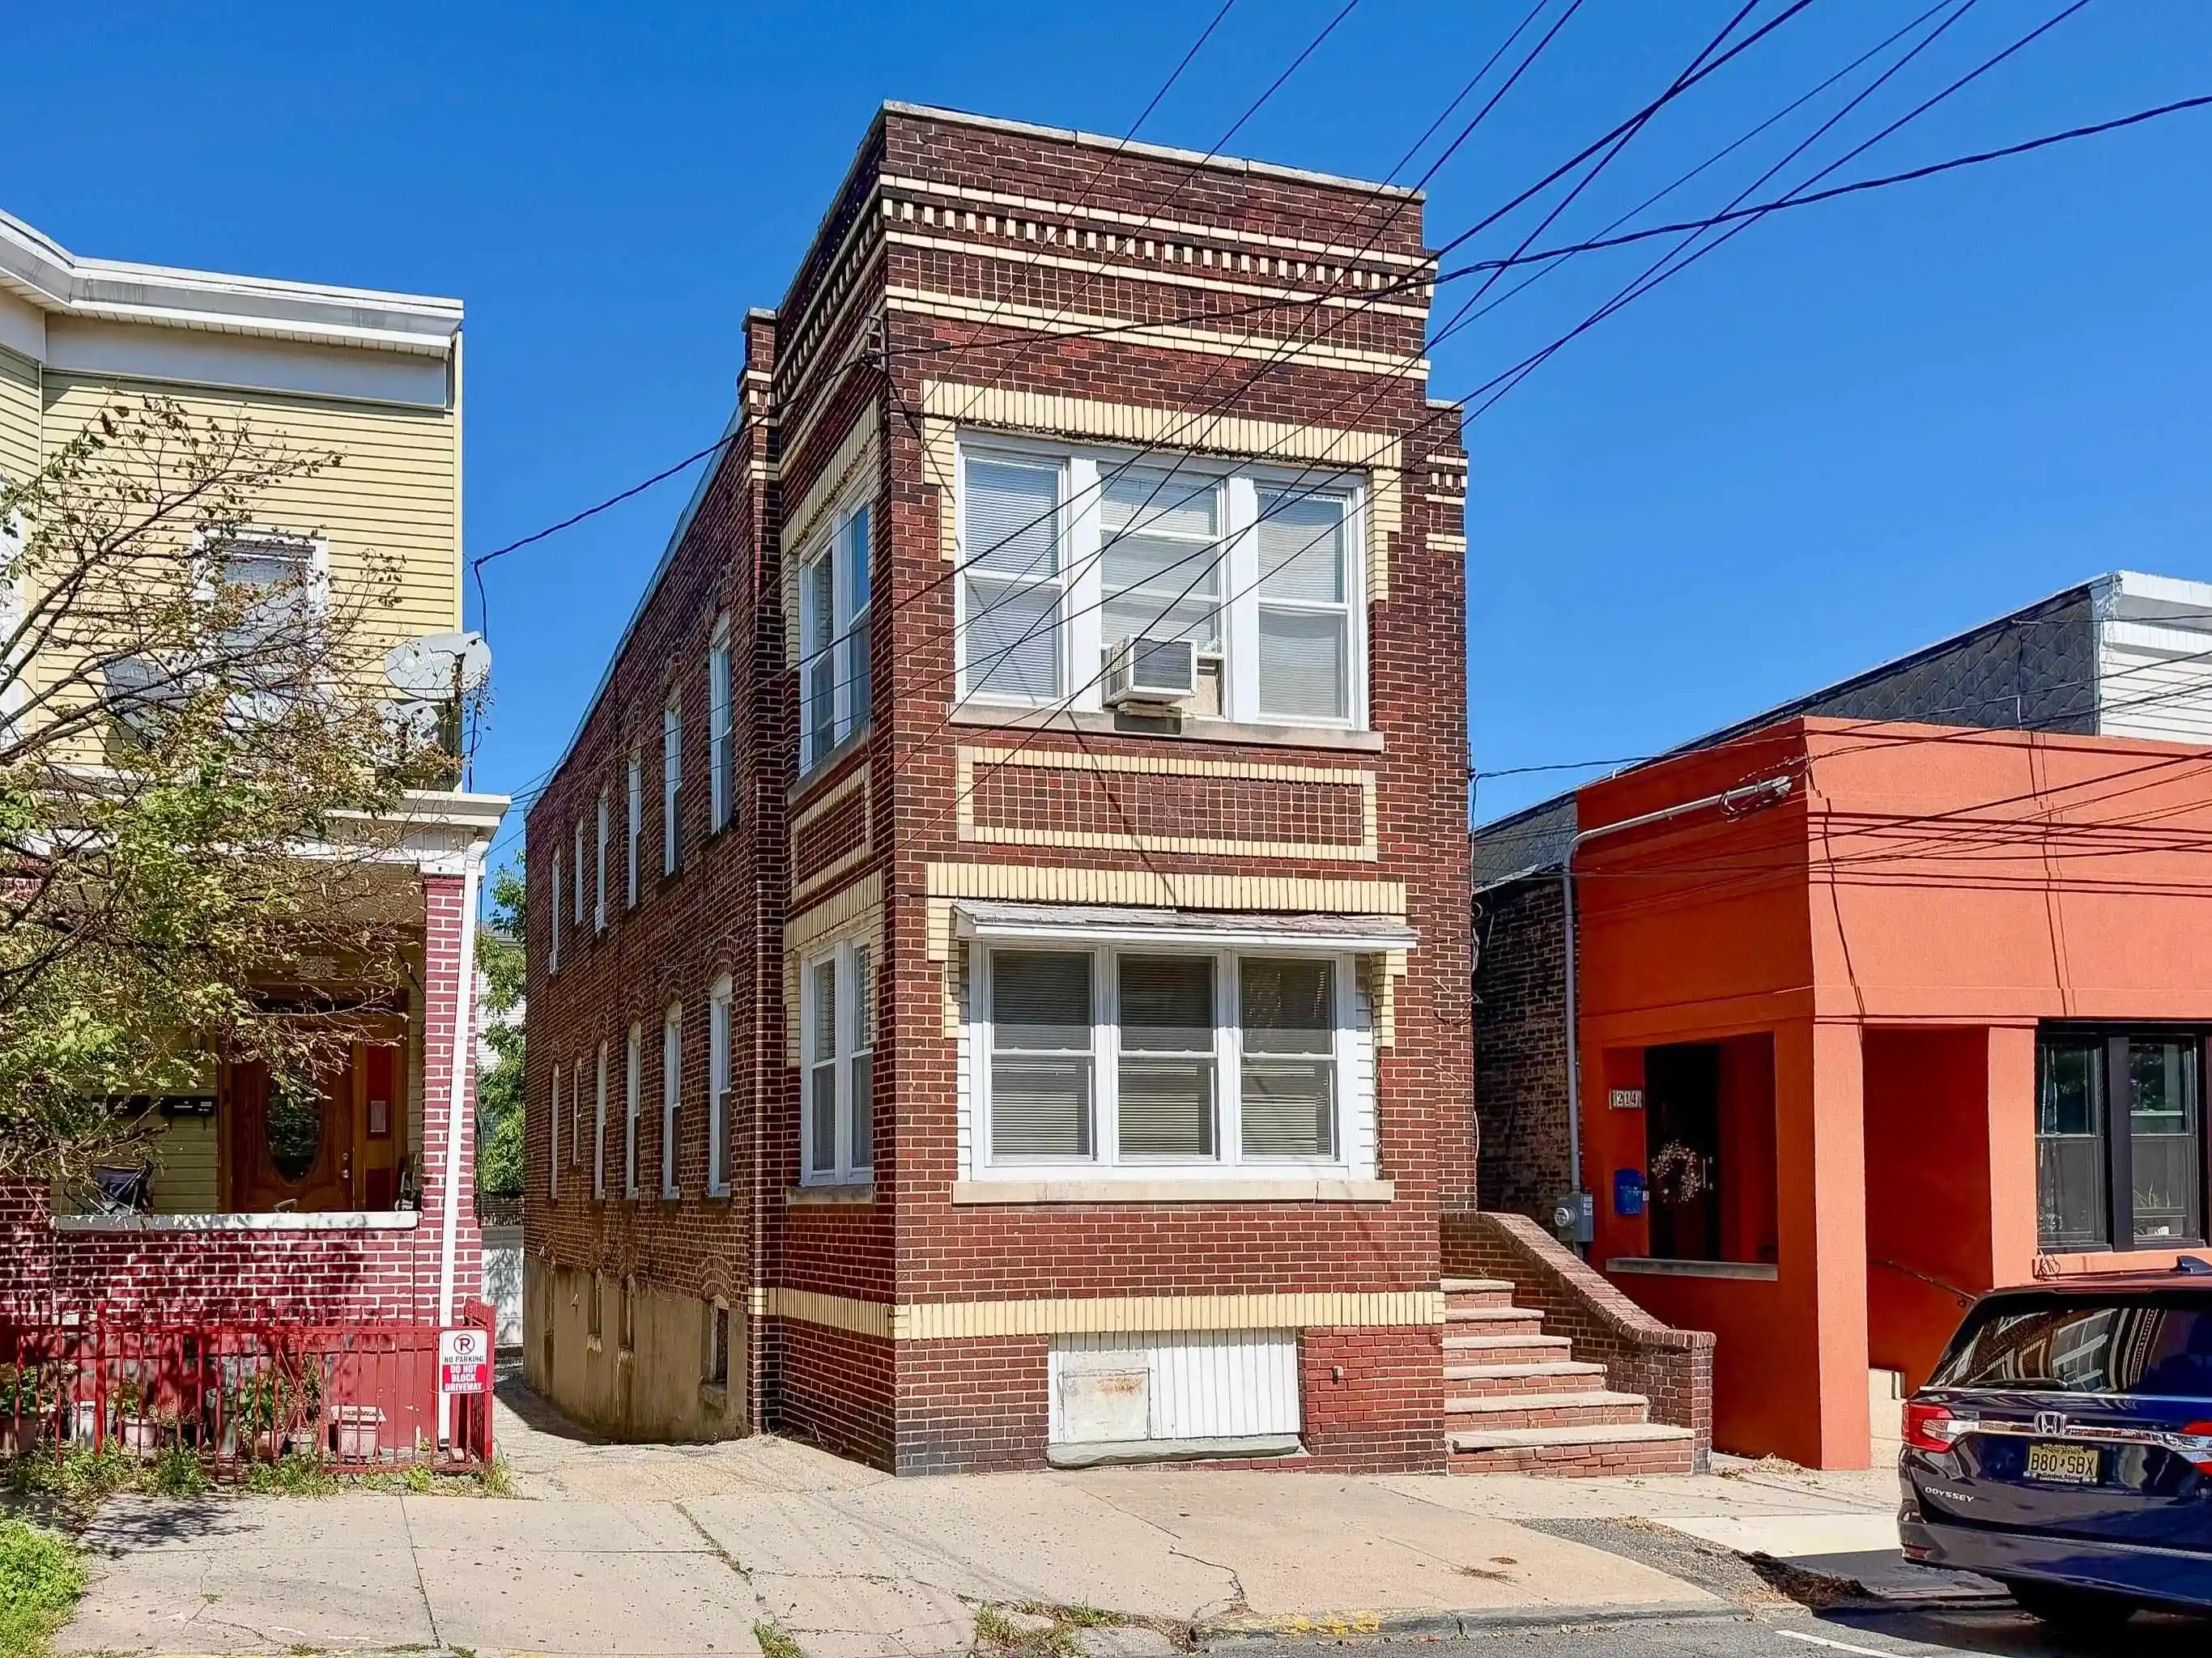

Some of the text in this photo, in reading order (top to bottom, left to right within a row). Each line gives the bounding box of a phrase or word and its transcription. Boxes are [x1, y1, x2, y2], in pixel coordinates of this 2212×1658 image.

[1618, 1091, 1637, 1105] 214
[449, 1365, 478, 1374] DO NOT
[451, 1373, 476, 1382] BLOCK
[445, 1382, 483, 1391] DRIVEWAY
[2031, 1452, 2094, 1477] B80 SBX
[1925, 1486, 1975, 1503] ODYSSEY
